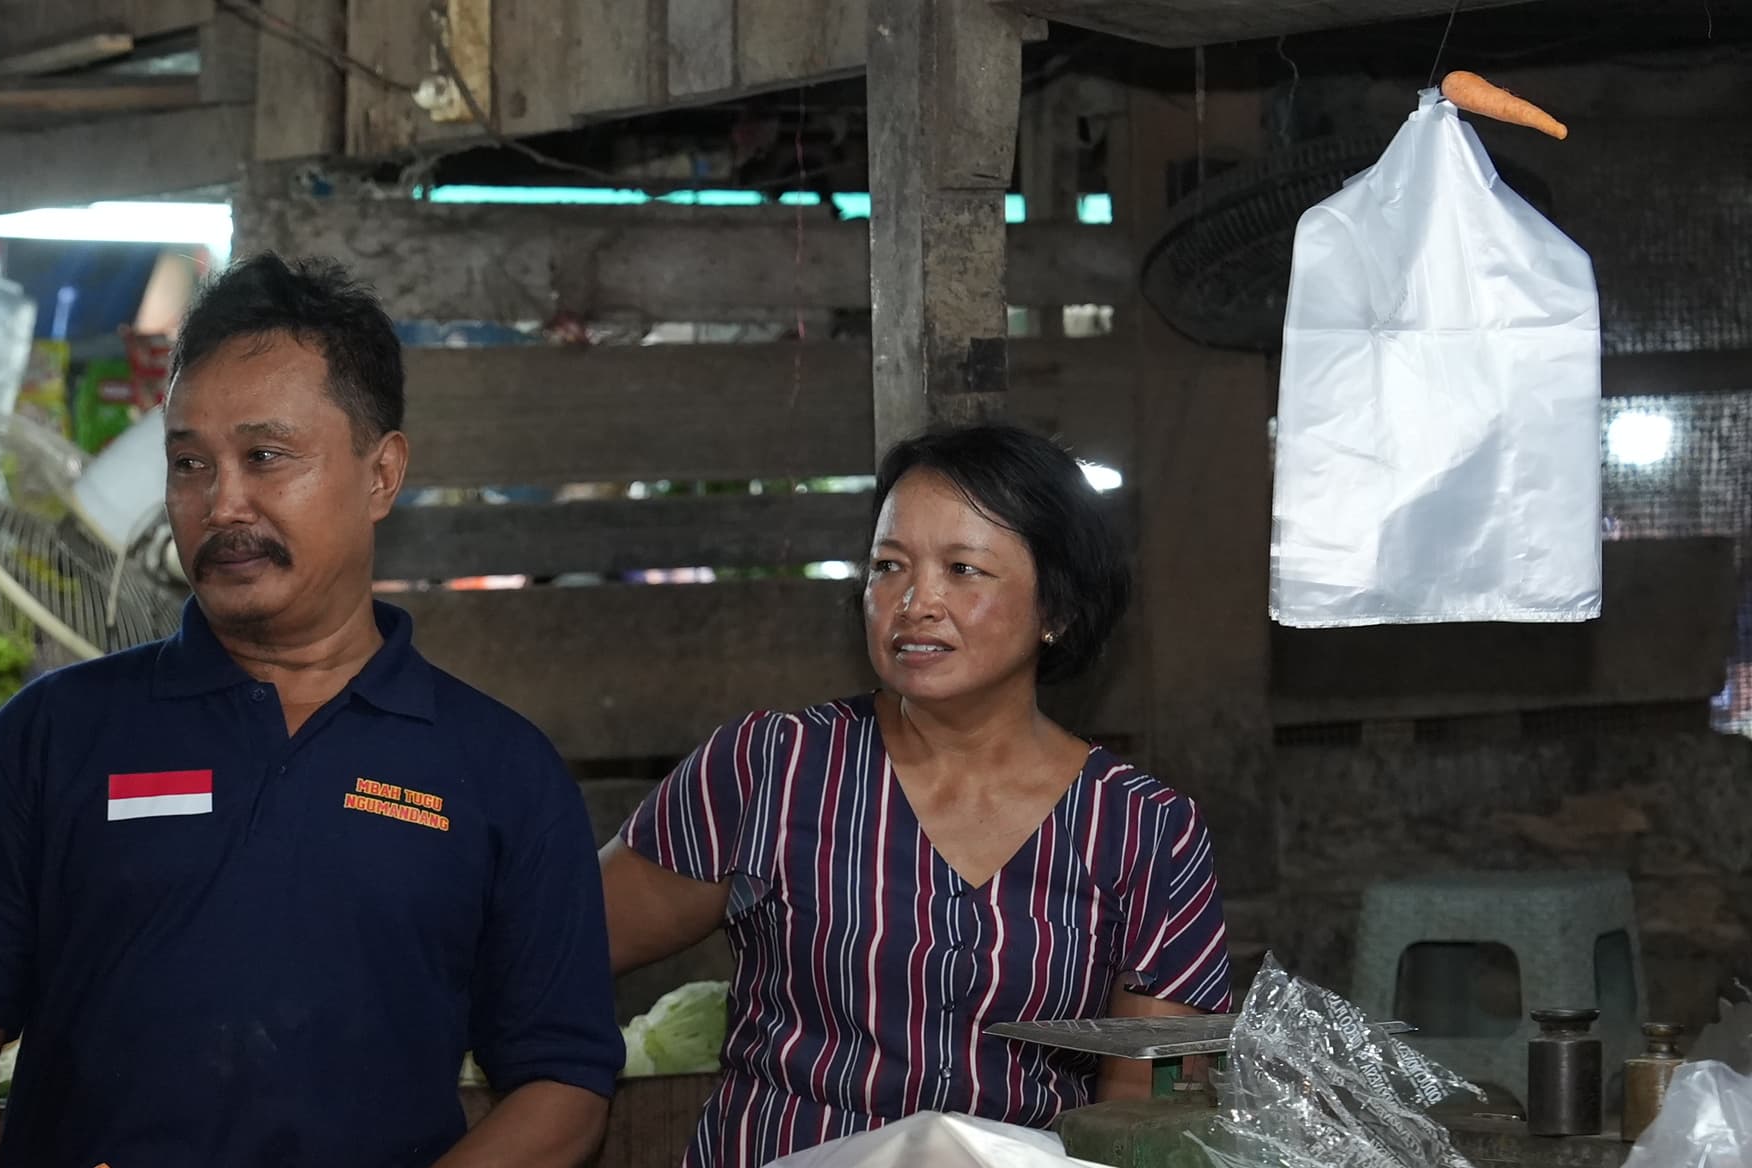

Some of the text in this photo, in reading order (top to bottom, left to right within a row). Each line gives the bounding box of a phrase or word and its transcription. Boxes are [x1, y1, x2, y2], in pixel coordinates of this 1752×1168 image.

[344, 793, 450, 831] NGUMANDANG
[355, 777, 443, 812] MBAH TUGU
